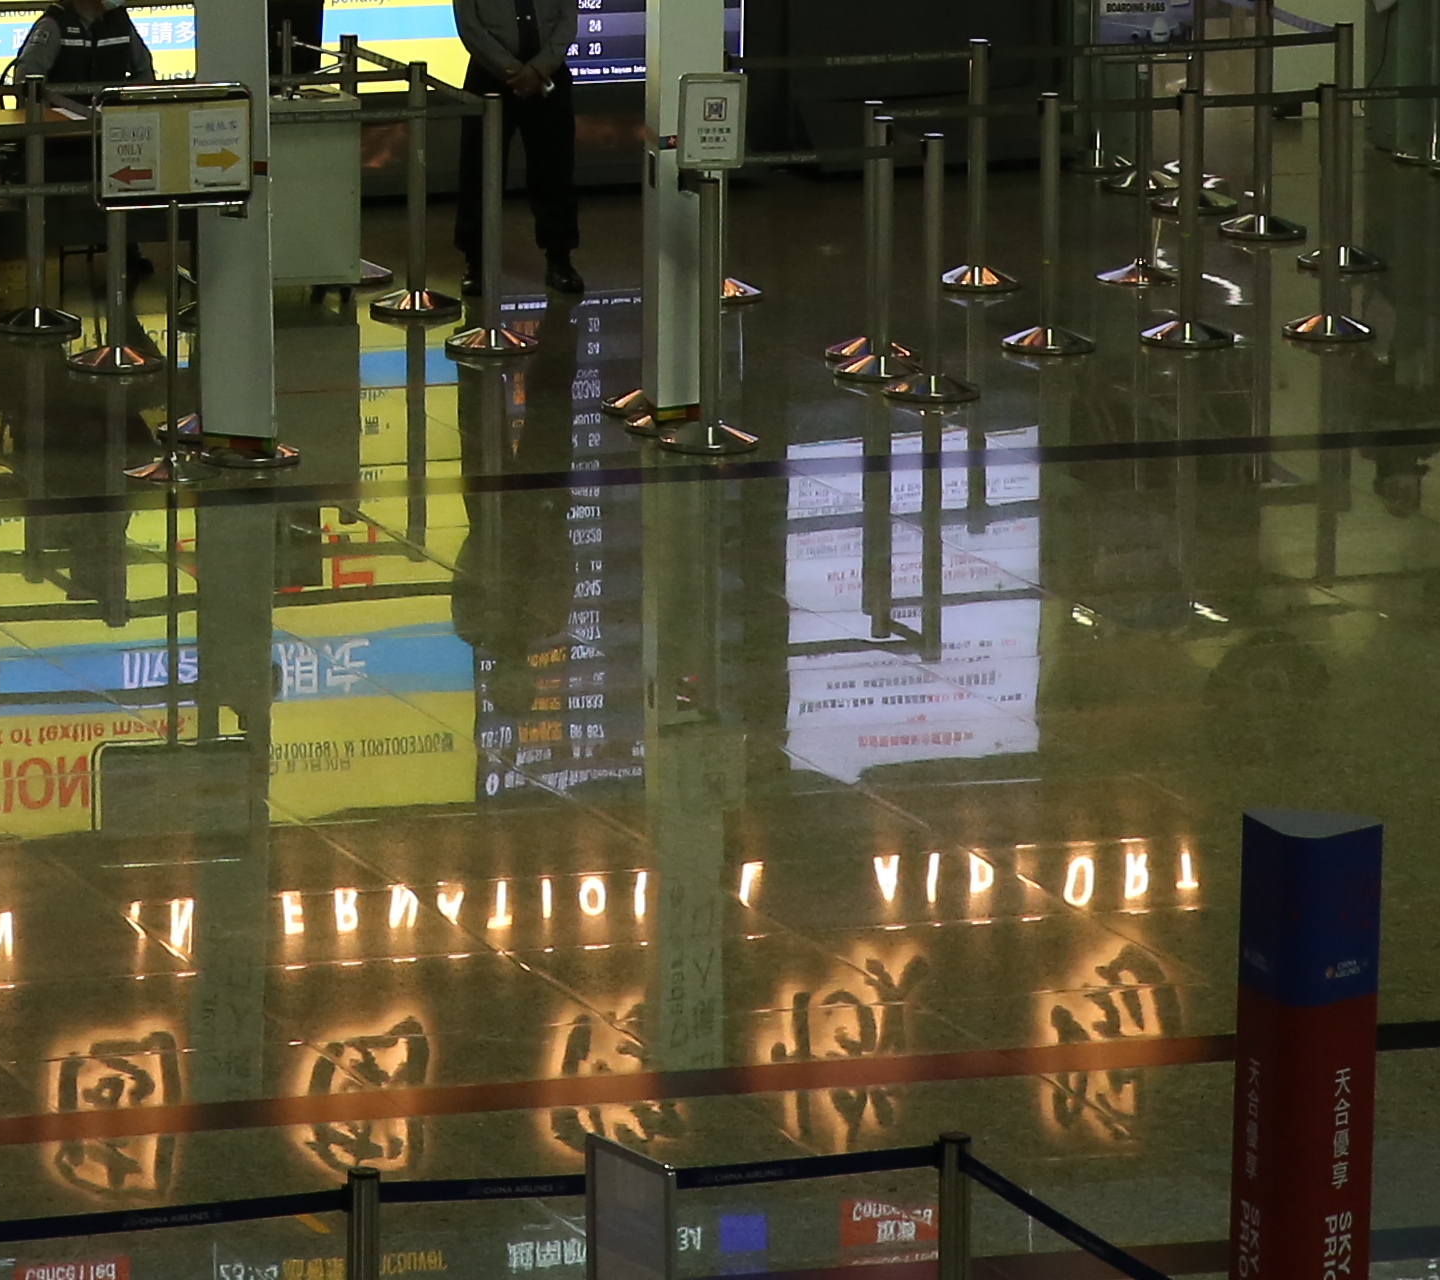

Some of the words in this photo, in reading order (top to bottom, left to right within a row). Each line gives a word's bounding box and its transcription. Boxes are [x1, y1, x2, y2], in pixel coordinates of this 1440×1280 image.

[117, 144, 143, 156] ONLY
[1331, 1067, 1352, 1190] 天合優享
[1338, 1211, 1352, 1275] SKY
